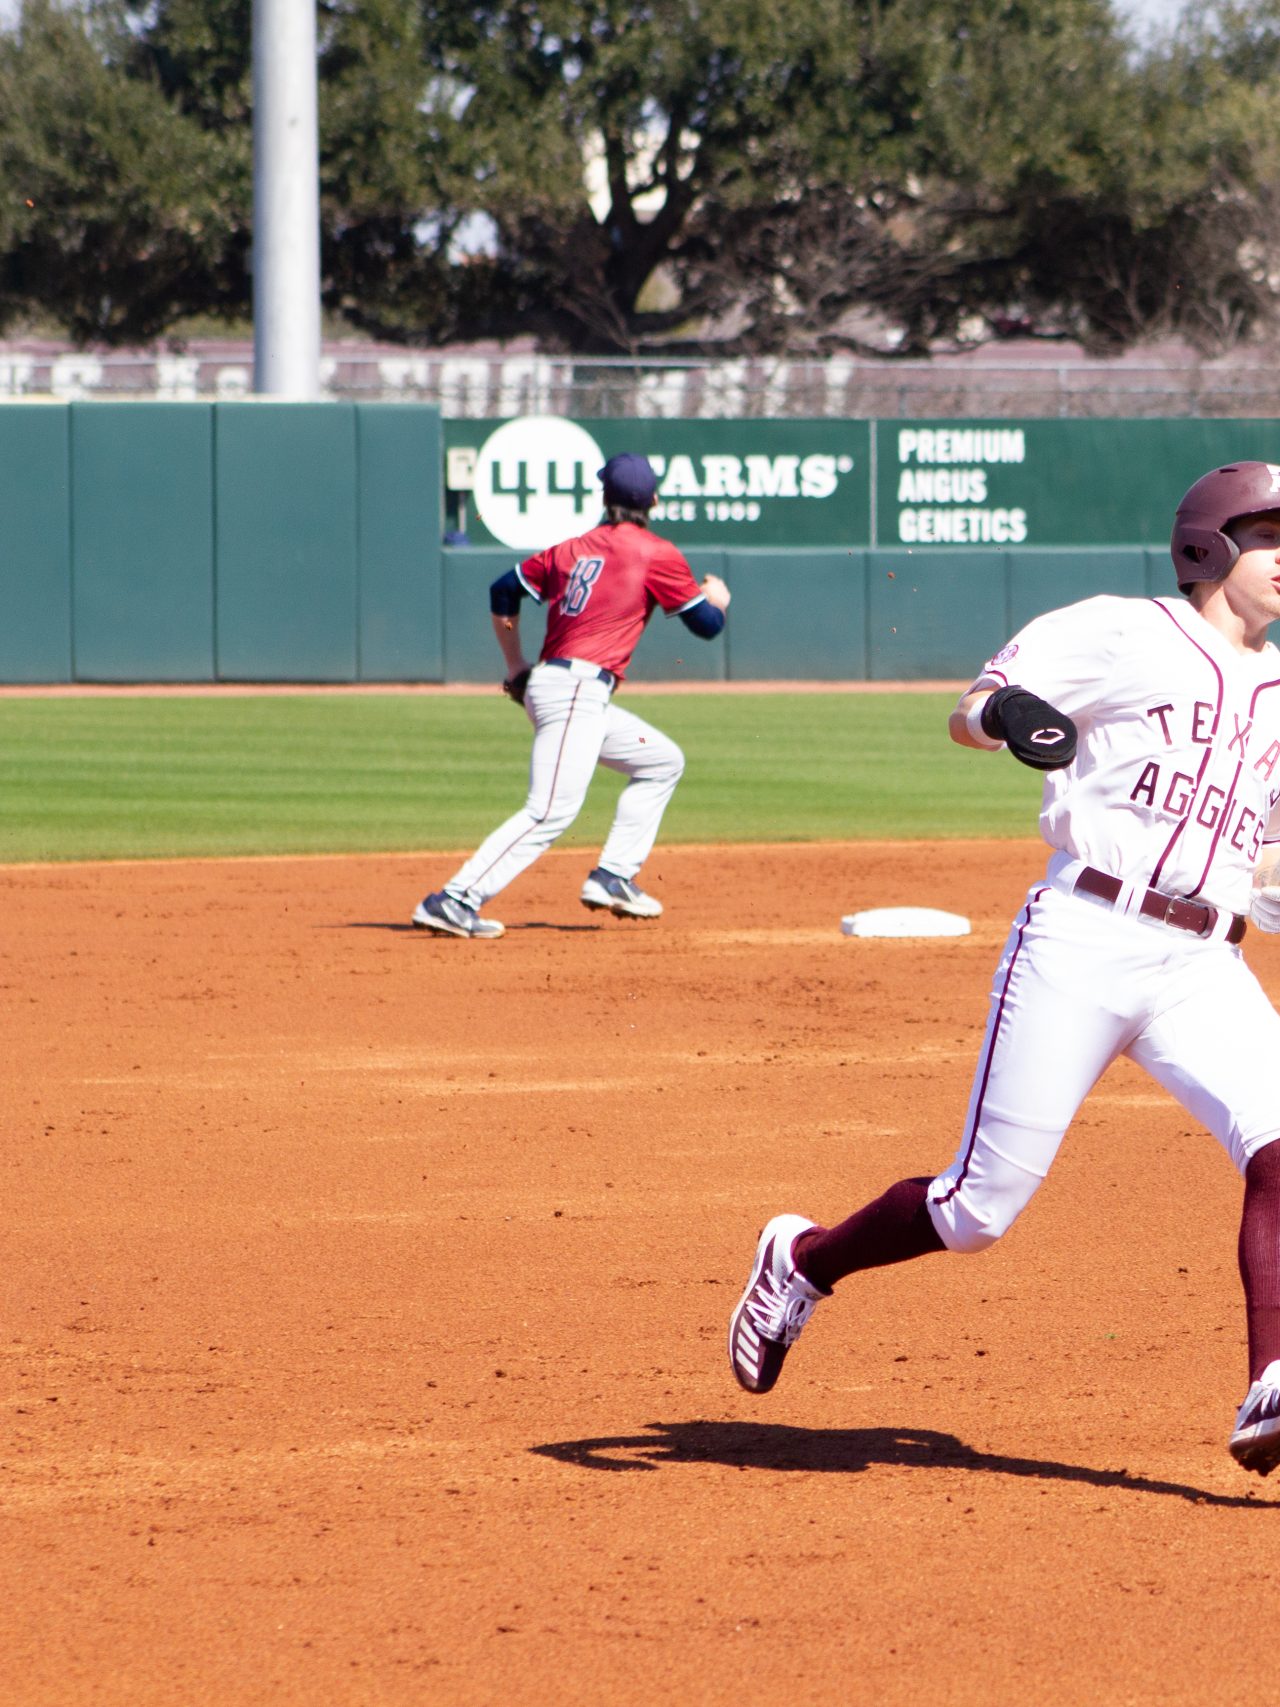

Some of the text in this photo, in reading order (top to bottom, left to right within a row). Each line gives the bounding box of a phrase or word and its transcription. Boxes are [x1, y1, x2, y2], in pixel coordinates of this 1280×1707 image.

[898, 428, 1025, 463] PREMIUM
[491, 461, 593, 514] 44
[898, 468, 988, 503] ANGUS
[649, 501, 697, 521] NCE
[898, 507, 1027, 543] GENETICS
[1130, 761, 1264, 863] AGGIES
